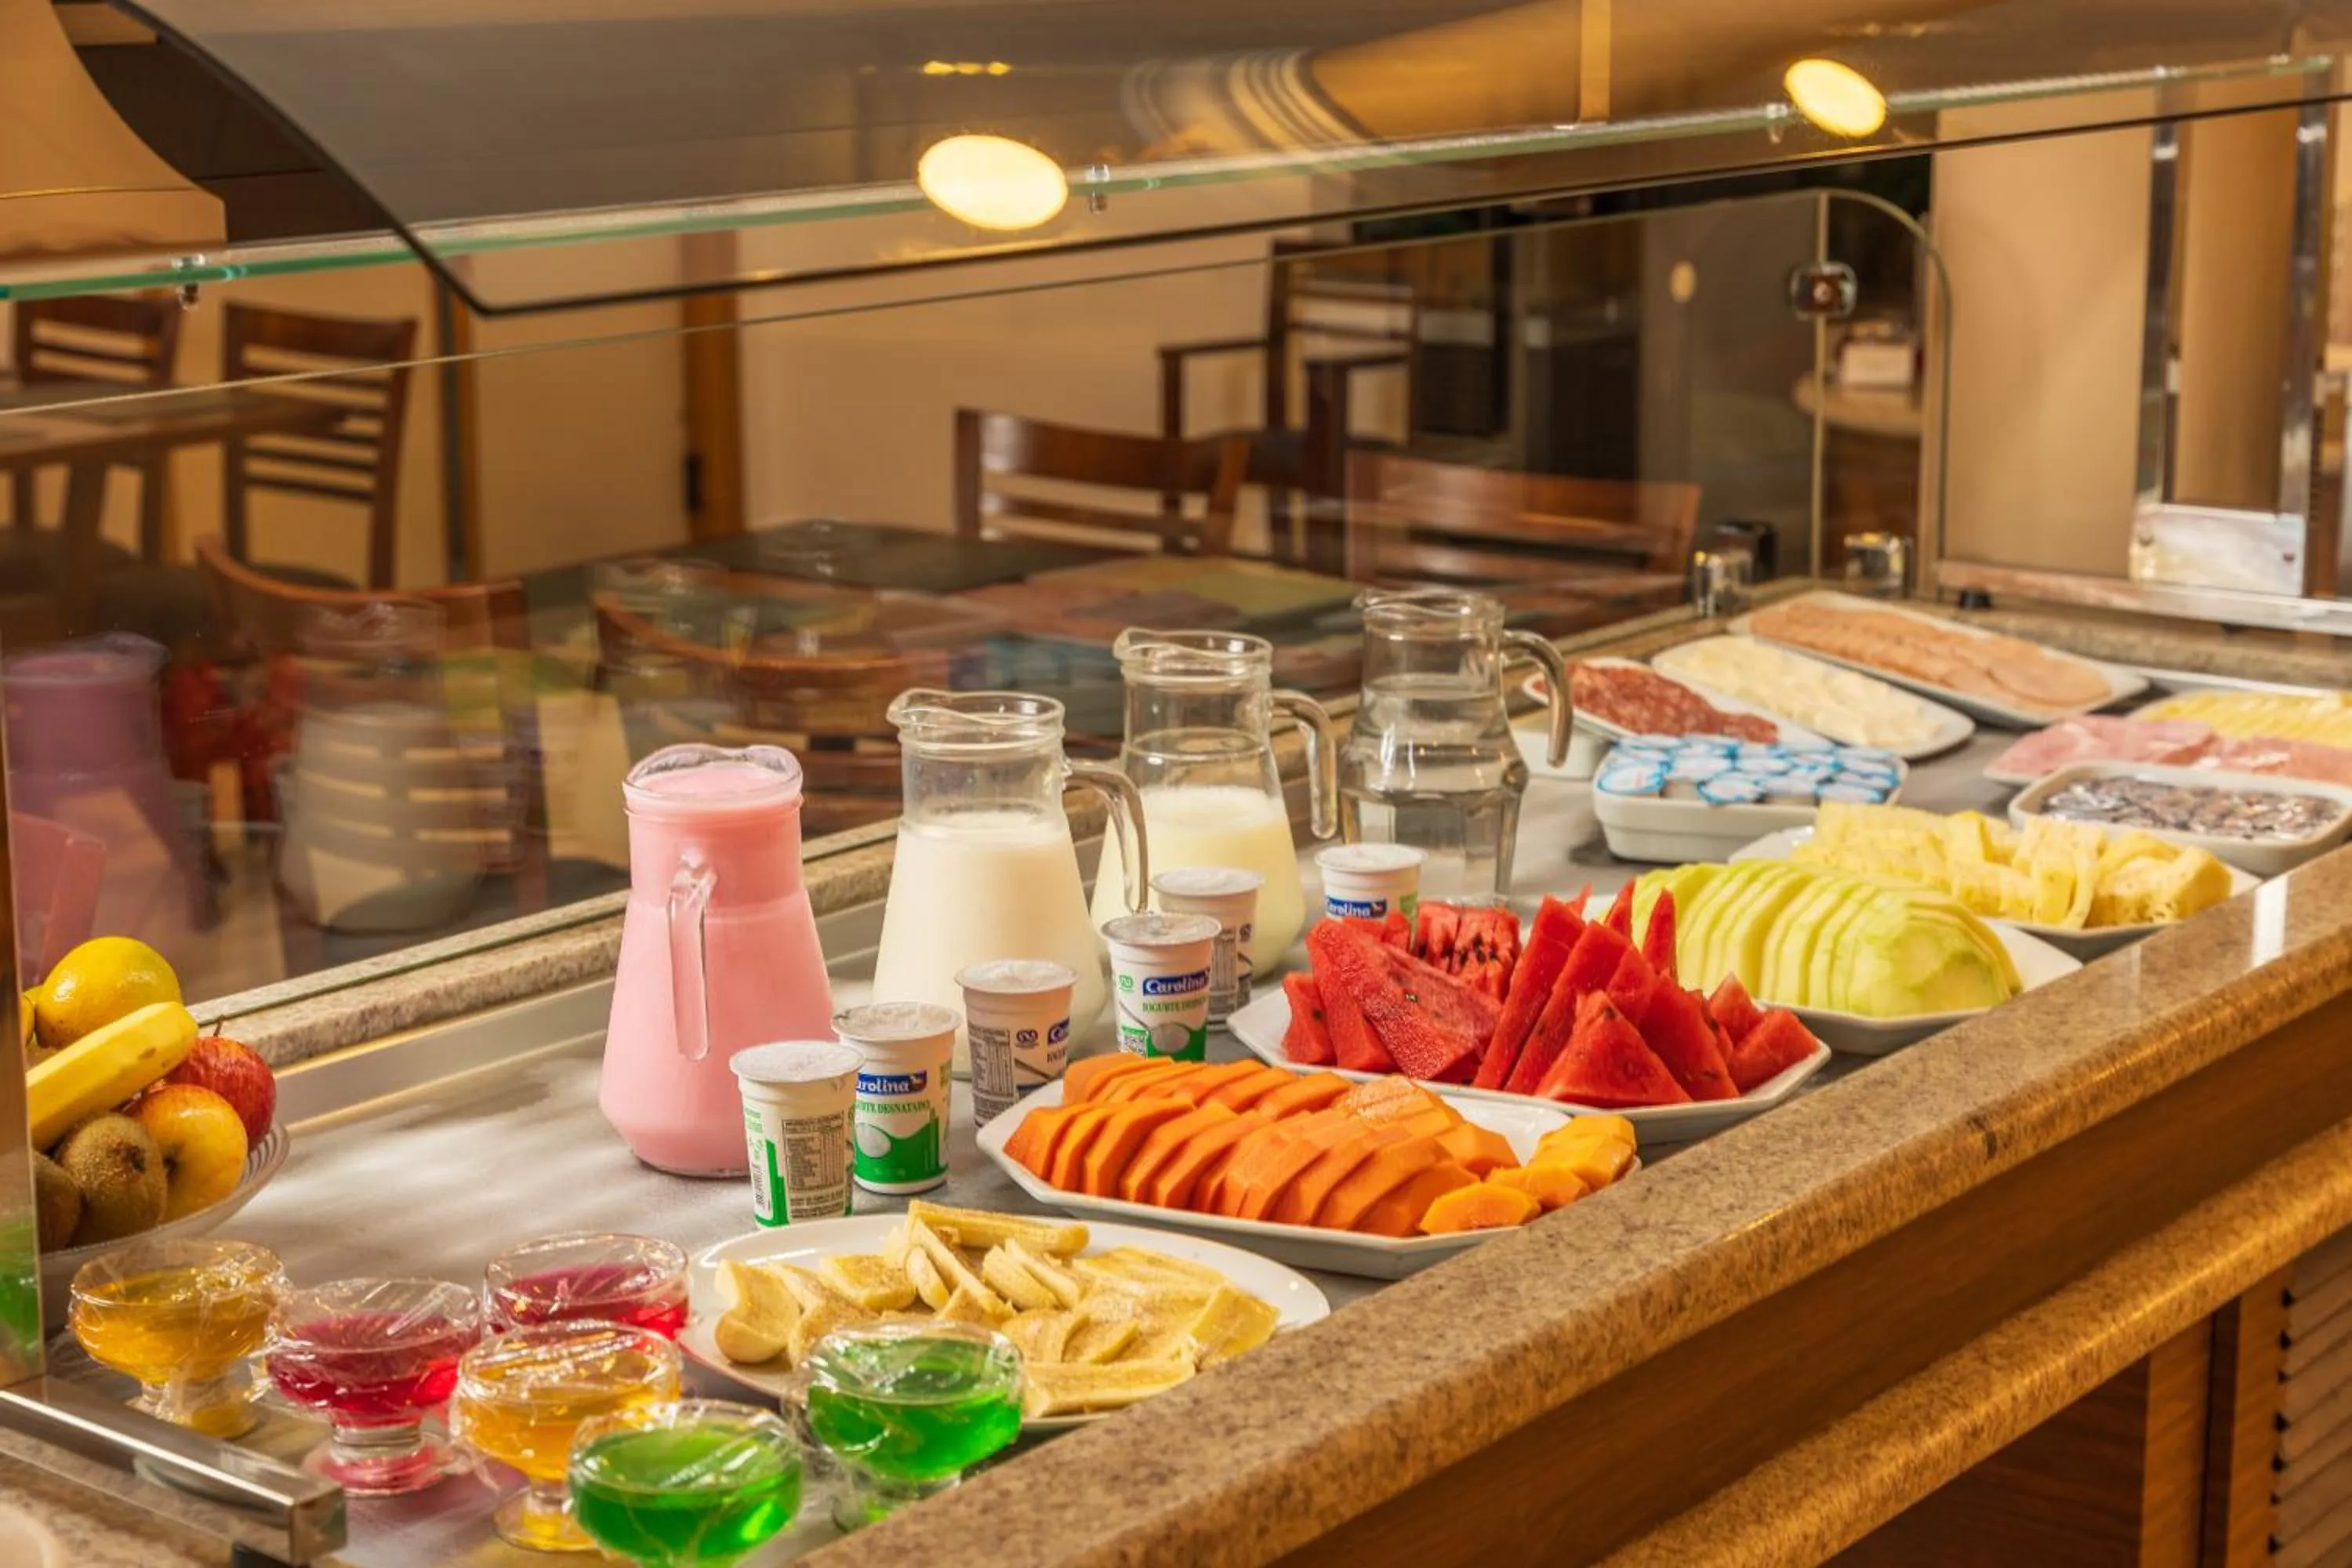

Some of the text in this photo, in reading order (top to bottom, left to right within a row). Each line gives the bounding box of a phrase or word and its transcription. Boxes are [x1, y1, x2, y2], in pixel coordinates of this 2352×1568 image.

[1328, 902, 1371, 916] rolina
[1145, 975, 1206, 994] Carolina
[856, 1077, 910, 1092] rolina
